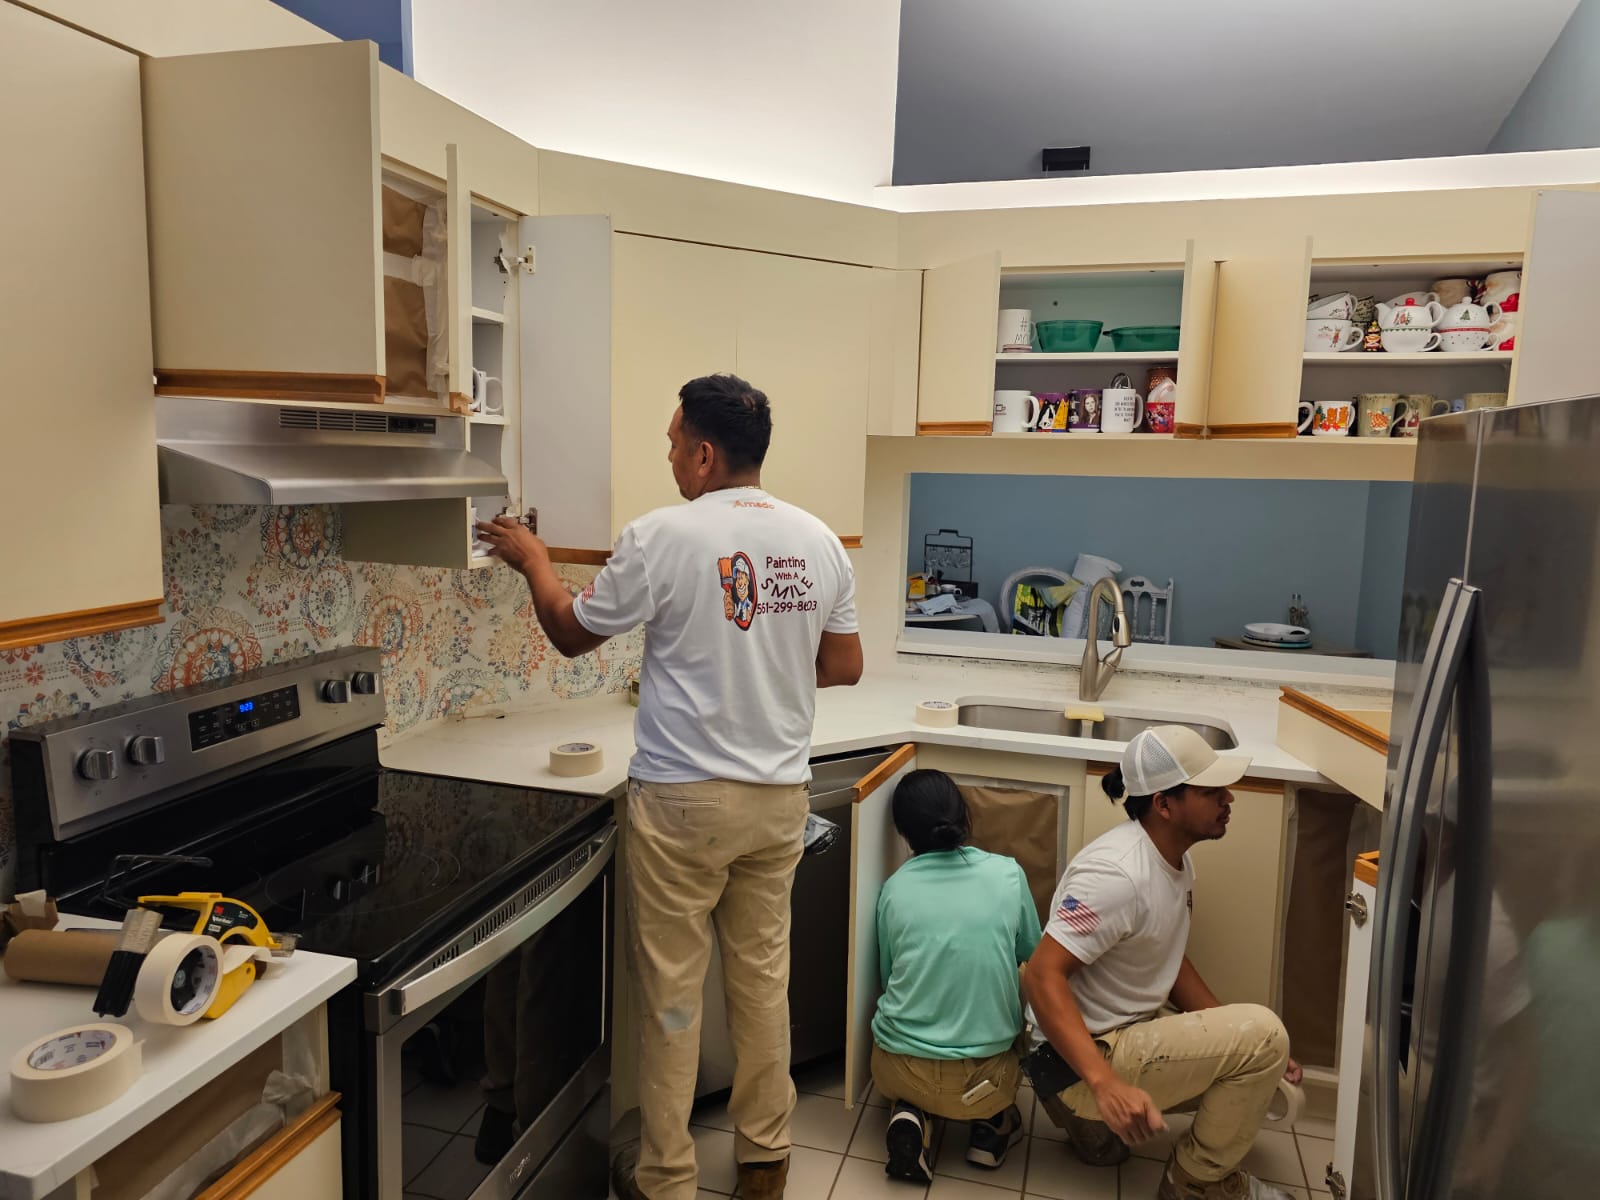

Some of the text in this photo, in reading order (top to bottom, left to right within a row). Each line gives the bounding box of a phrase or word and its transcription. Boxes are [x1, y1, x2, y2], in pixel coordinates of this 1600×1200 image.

[766, 556, 806, 571] Painting
[775, 571, 799, 580] With A
[761, 576, 814, 599] SMILE
[757, 600, 817, 614] 561-299-8603
